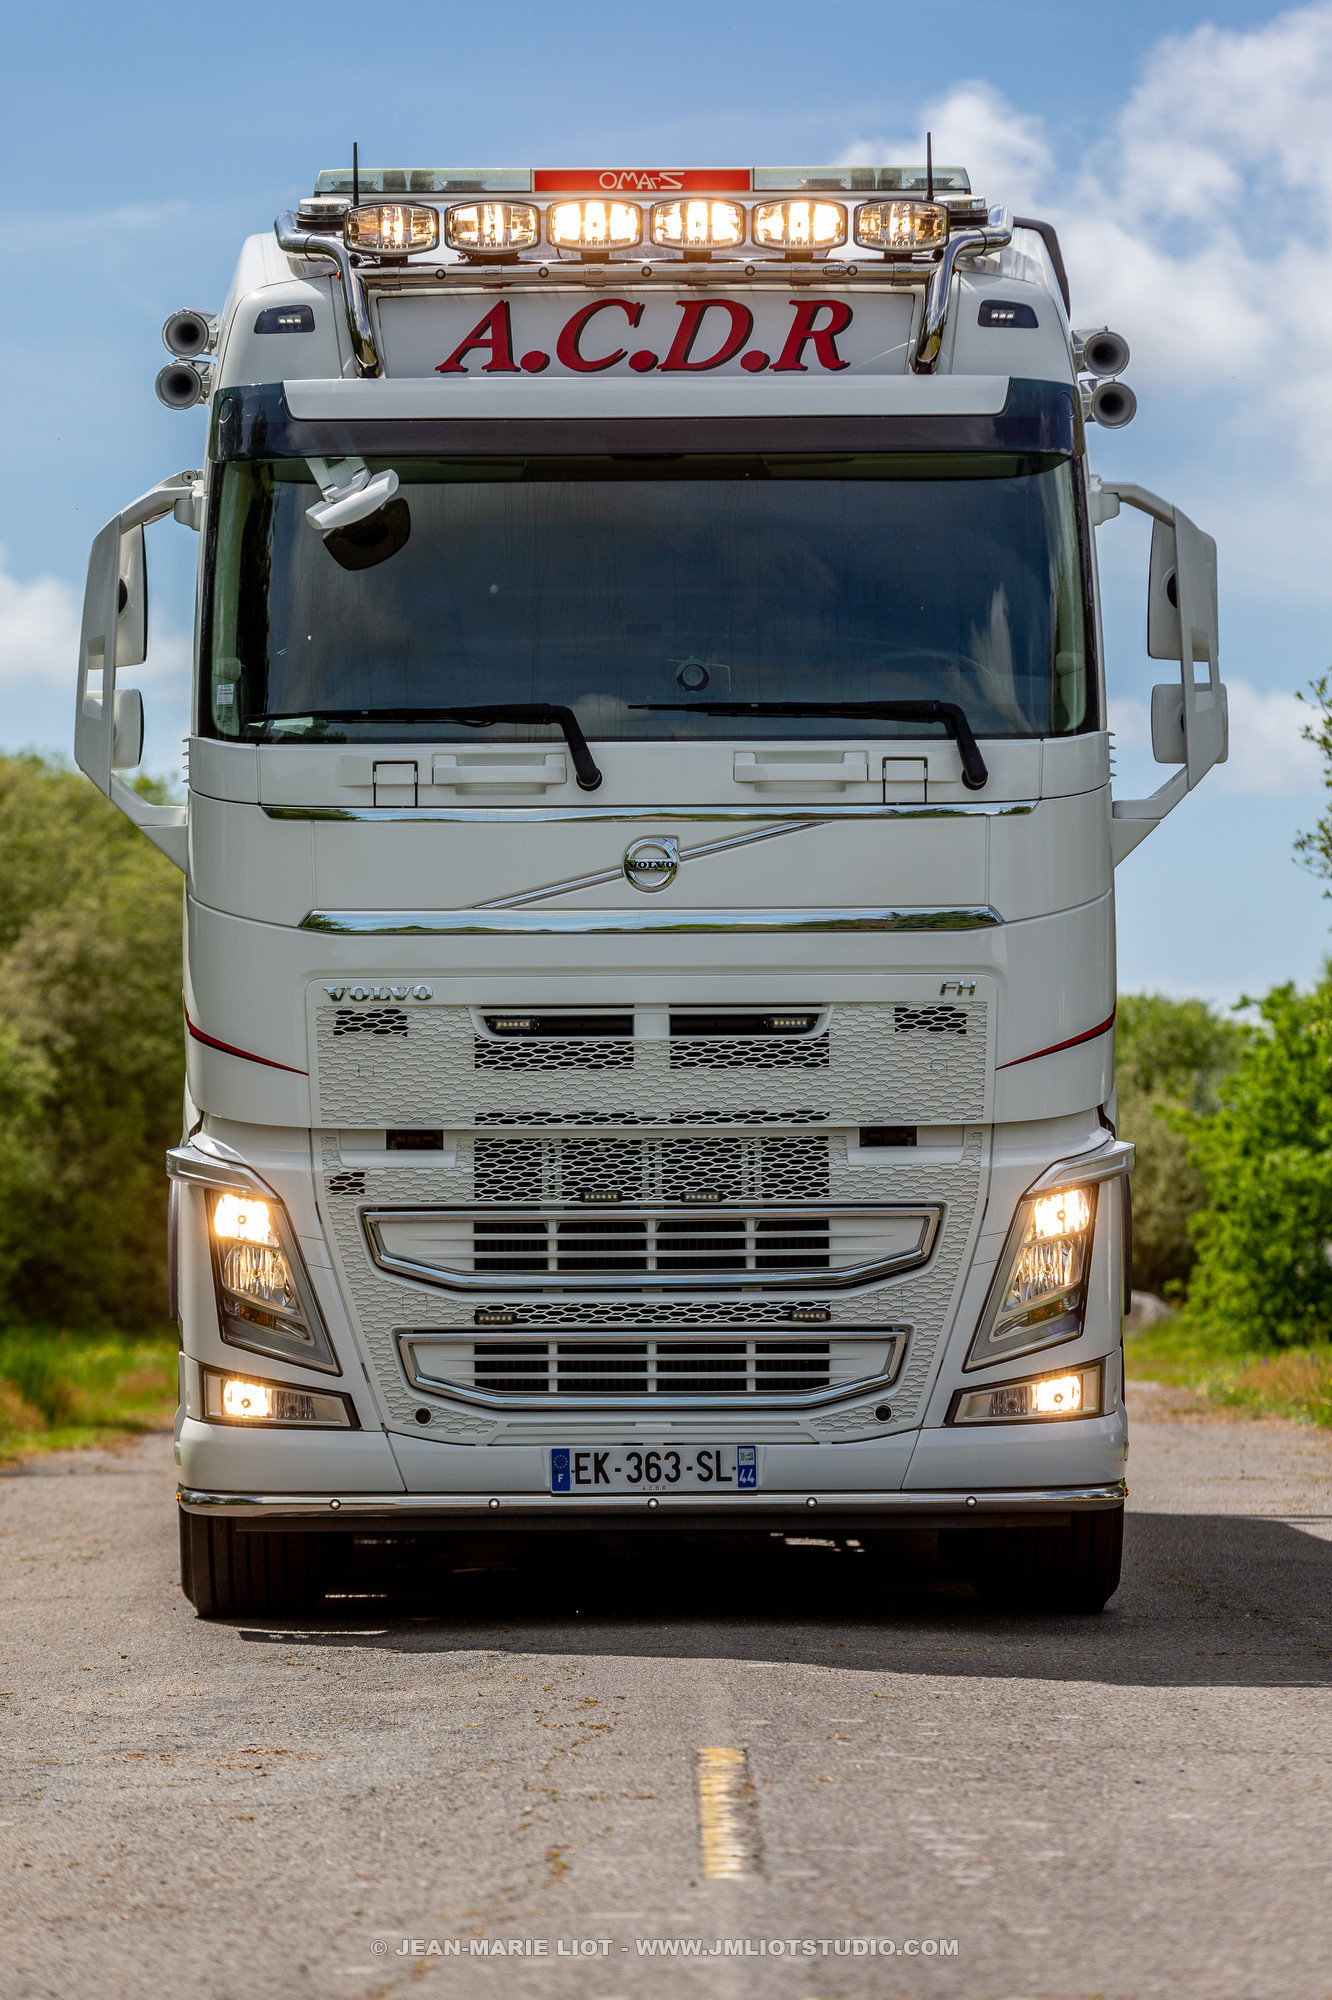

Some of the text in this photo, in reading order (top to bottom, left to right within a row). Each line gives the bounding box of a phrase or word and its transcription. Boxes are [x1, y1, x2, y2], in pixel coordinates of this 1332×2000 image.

[434, 298, 854, 373] A.C.D.R
[627, 860, 675, 869] VOLVO
[322, 985, 434, 1002] VOLVO
[939, 980, 977, 996] FH
[574, 1450, 733, 1485] EK-363-SL
[739, 1468, 755, 1483] 44
[558, 1473, 565, 1483] F
